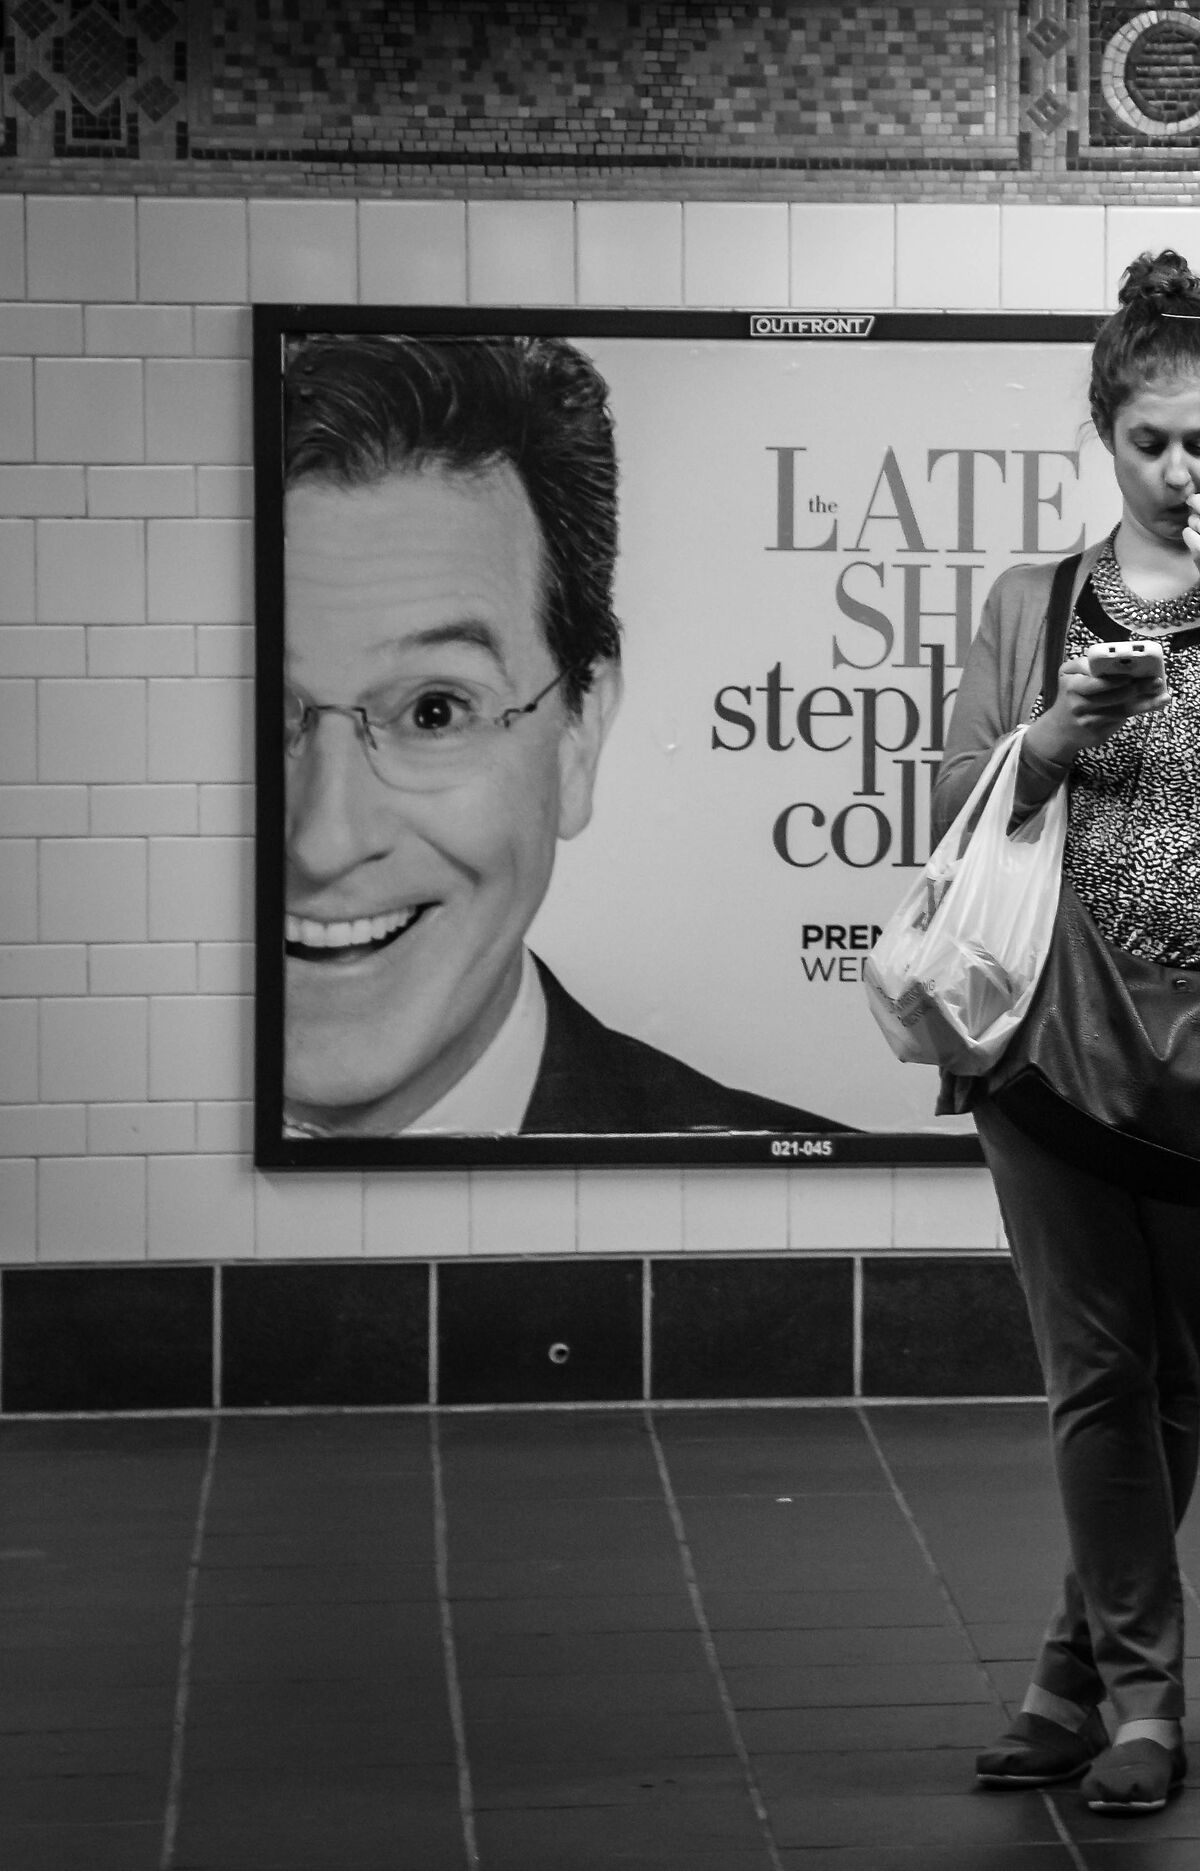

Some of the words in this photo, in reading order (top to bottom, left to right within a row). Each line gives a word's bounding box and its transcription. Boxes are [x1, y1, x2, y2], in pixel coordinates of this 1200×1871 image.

[756, 318, 865, 333] OUTFRONT
[764, 445, 1086, 554] LATE
[808, 495, 838, 513] the
[832, 561, 985, 669] SH
[771, 1140, 833, 1156] 021-045
